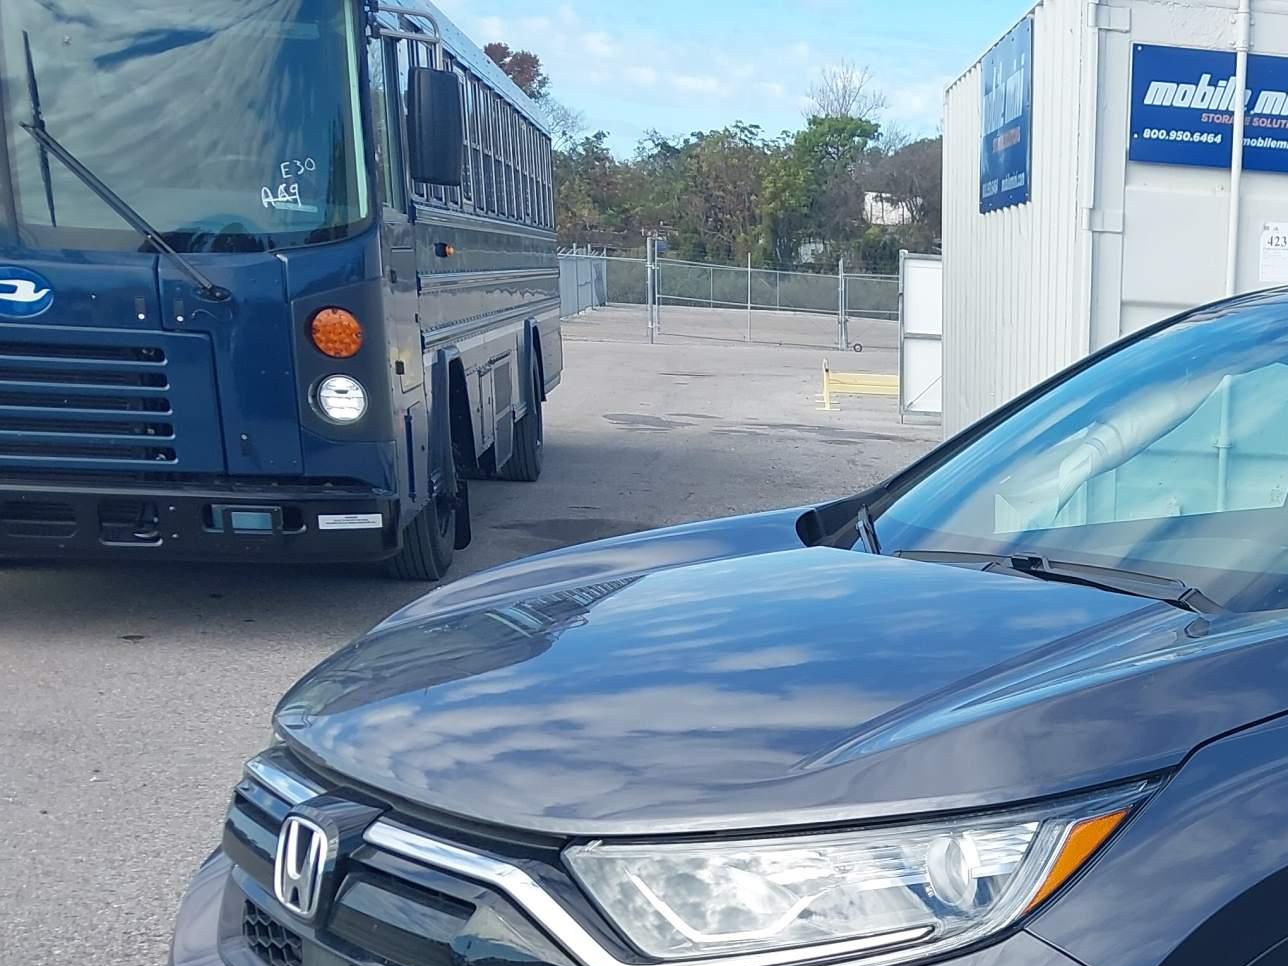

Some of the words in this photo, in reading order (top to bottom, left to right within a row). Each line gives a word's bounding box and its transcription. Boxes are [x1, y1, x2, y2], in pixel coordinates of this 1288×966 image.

[1201, 112, 1250, 126] STORAE
[1143, 128, 1222, 145] 800.950.6464
[280, 157, 316, 179] E30
